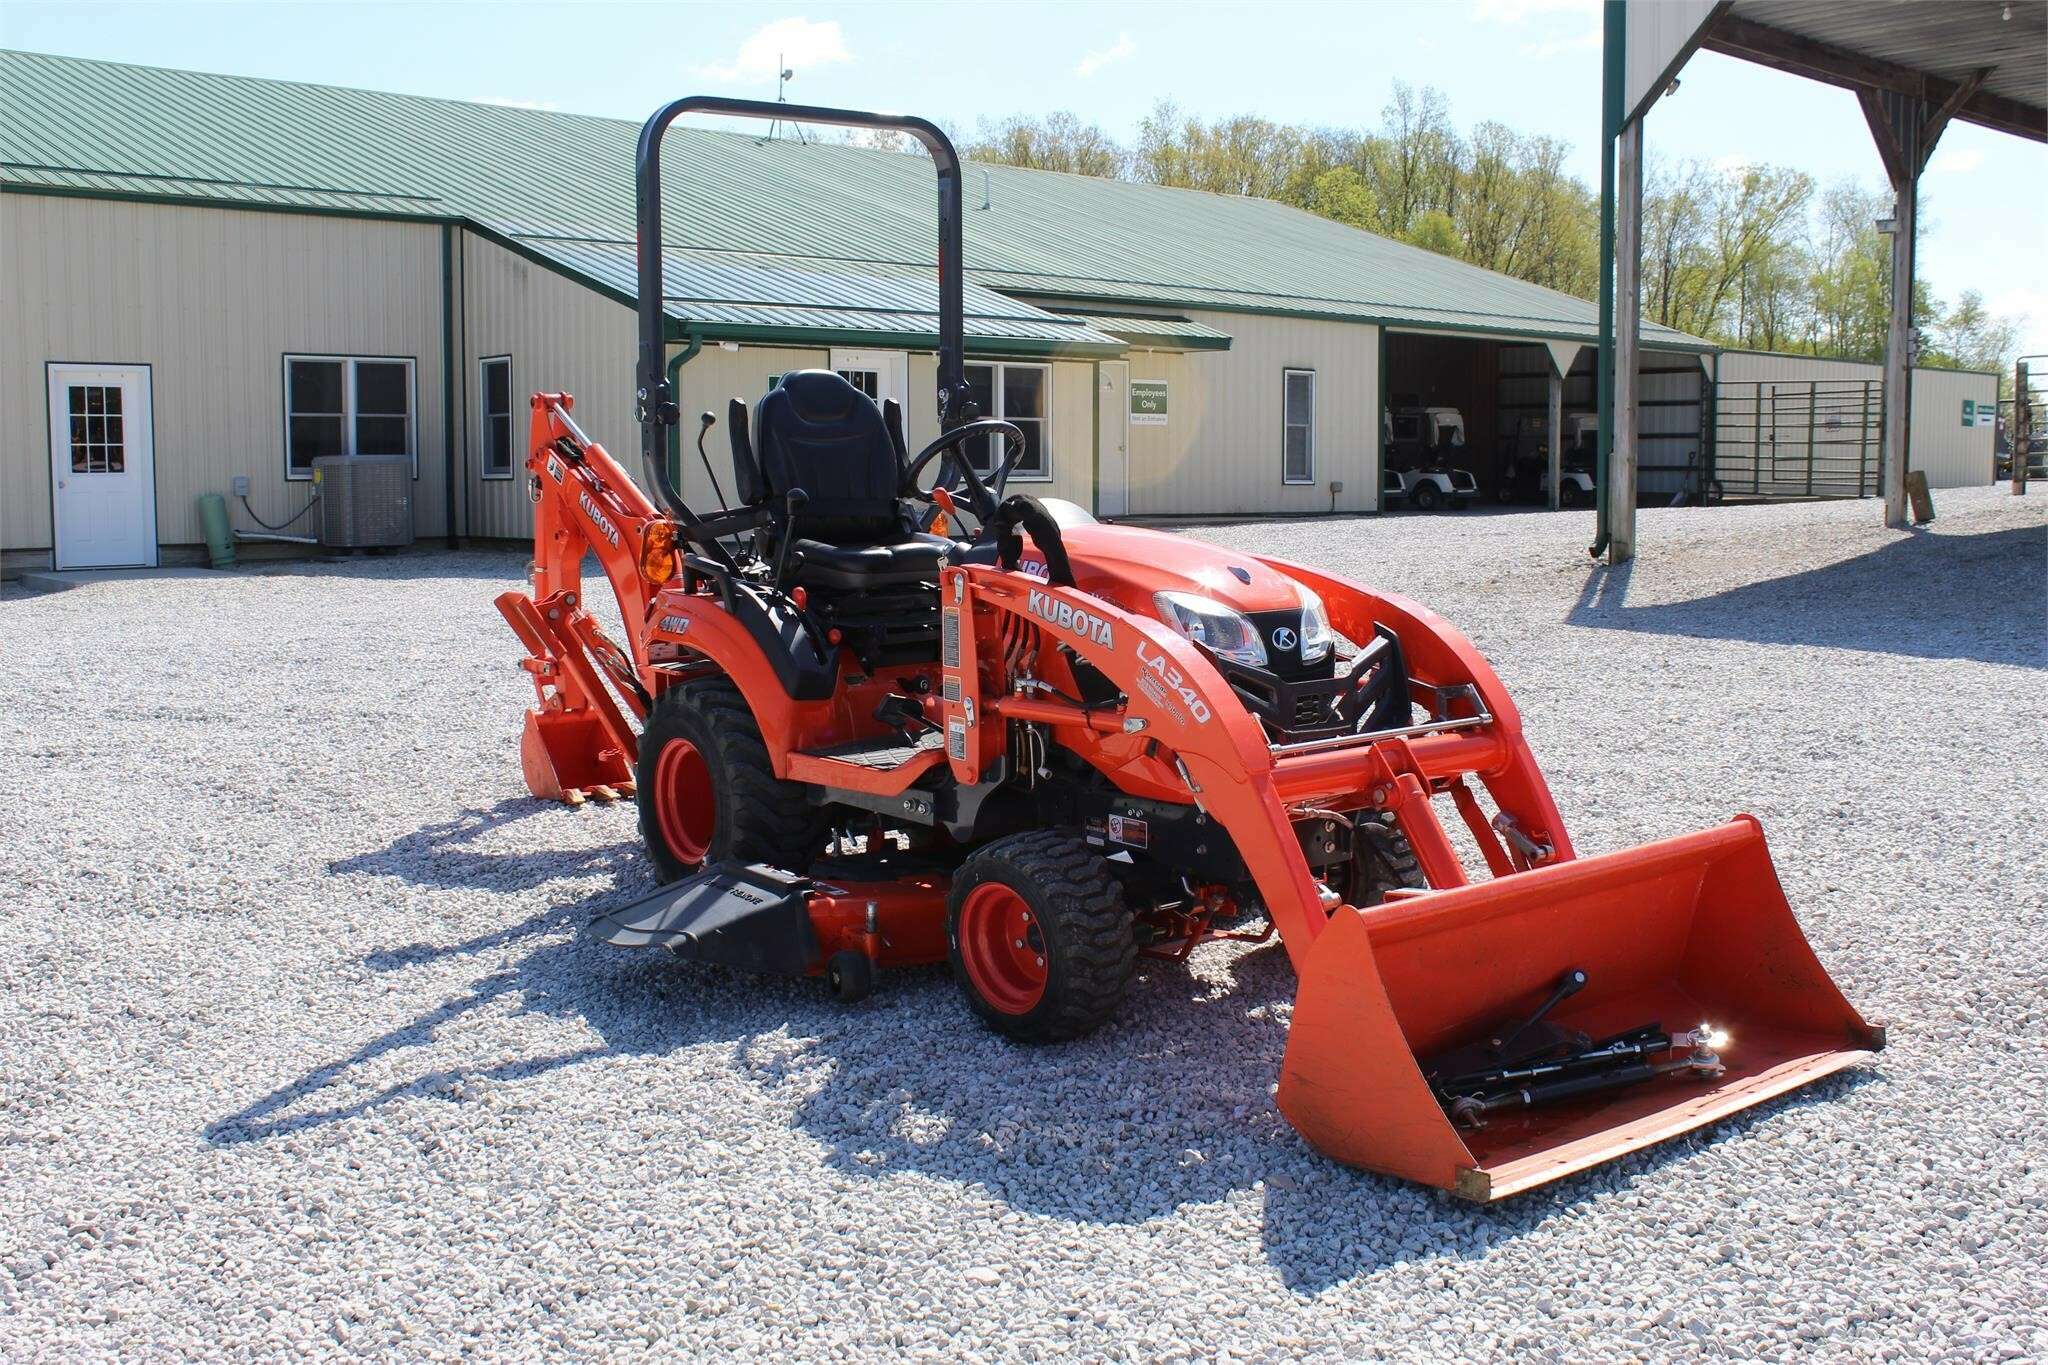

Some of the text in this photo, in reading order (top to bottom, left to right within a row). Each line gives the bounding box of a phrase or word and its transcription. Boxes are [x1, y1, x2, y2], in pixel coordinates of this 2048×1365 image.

[1132, 388, 1166, 398] Employees
[1141, 400, 1156, 410] Only
[579, 490, 619, 551] KUBOTA
[660, 615, 690, 635] 4WD
[1028, 588, 1115, 650] KUBOTA
[1136, 640, 1211, 724] LA340
